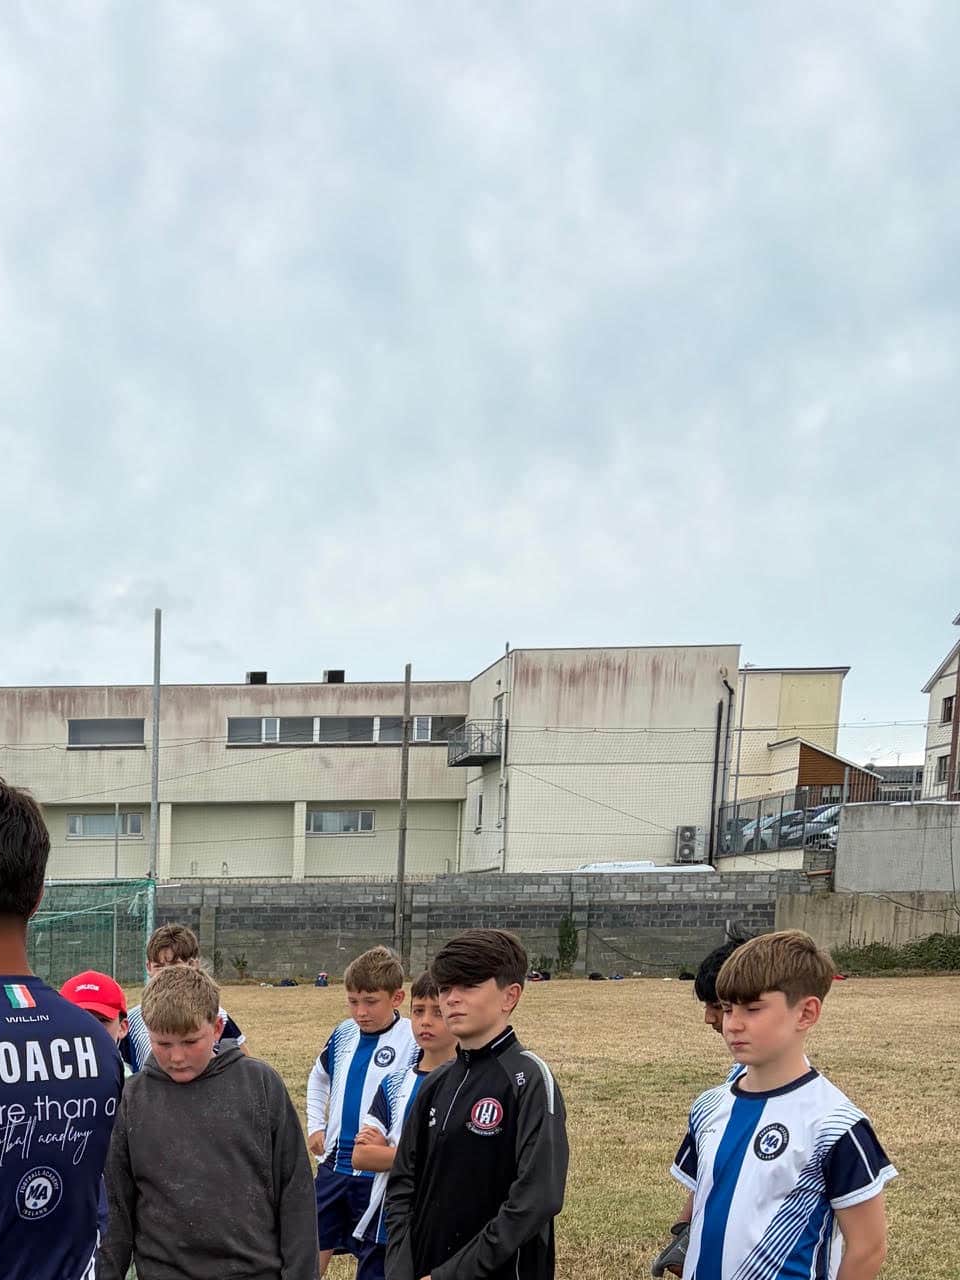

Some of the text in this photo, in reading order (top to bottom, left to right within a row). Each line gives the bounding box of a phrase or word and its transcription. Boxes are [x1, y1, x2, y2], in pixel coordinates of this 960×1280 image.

[5, 1014, 50, 1023] WILLIN
[34, 1095, 97, 1122] than
[104, 1097, 117, 1117] a
[761, 1133, 780, 1150] MA
[26, 1183, 49, 1201] MA
